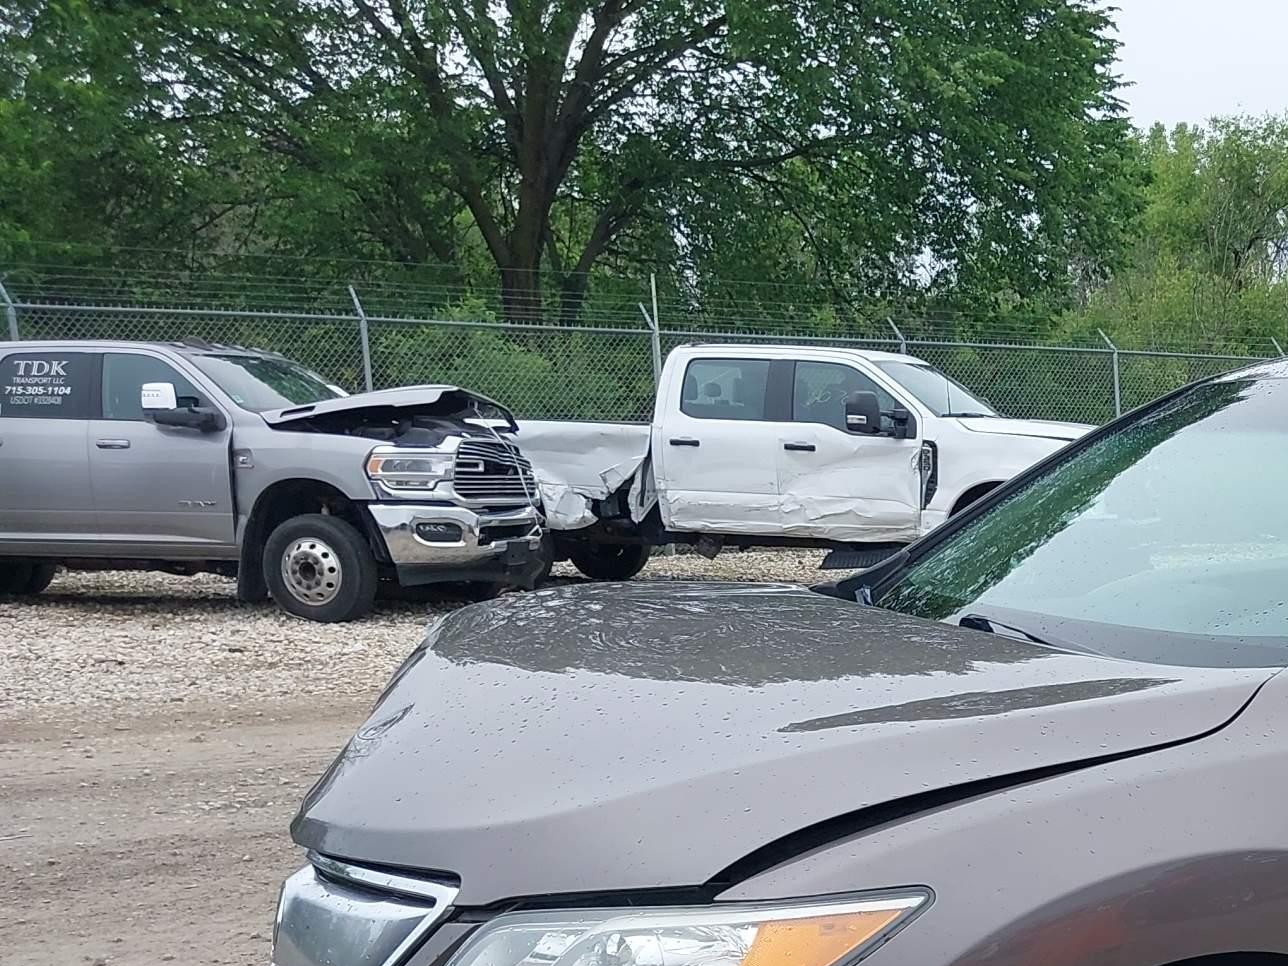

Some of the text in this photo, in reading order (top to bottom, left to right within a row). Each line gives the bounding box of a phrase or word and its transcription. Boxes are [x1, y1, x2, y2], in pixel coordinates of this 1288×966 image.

[13, 360, 70, 376] TDK
[12, 376, 52, 384] TRANSPORT
[4, 386, 71, 395] 715-305-1104
